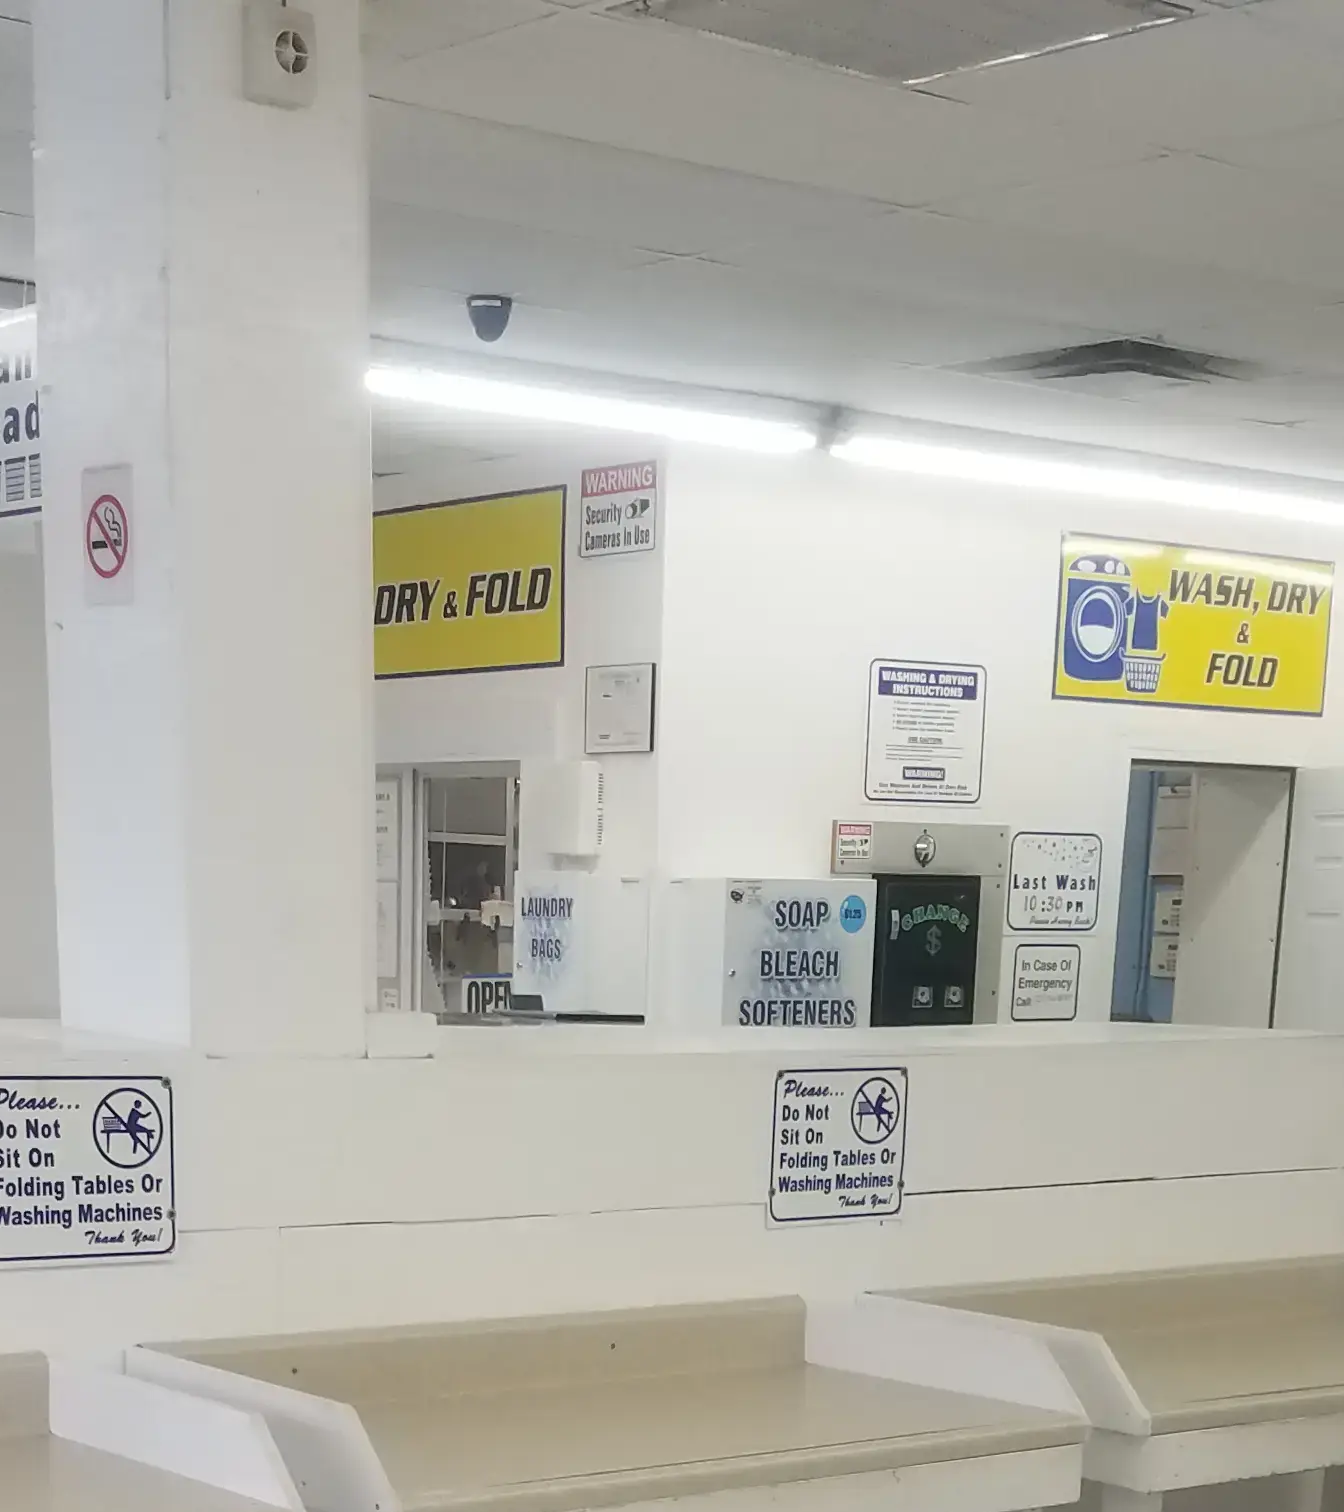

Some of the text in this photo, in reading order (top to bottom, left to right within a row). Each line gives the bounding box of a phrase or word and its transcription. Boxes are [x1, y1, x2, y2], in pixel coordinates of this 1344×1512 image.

[585, 465, 653, 494] WARNING
[585, 502, 622, 525] Security
[585, 525, 650, 551] Cameras In Use
[374, 567, 552, 625] DRY & FOLD
[1169, 569, 1326, 615] WASH, DRY
[1236, 623, 1250, 643] &
[881, 670, 926, 683] WASHING
[939, 675, 974, 686] DRYING
[1205, 653, 1278, 687] FOLD
[892, 684, 963, 697] INSTRUCTIONS
[1013, 874, 1095, 891] Last Wash
[521, 897, 574, 918] LAUNDRY
[774, 900, 830, 928] SOAP
[901, 904, 970, 932] CHANGE
[531, 938, 561, 959] BAGS
[760, 950, 839, 978] BLEACH
[1022, 959, 1031, 971] In
[1033, 959, 1058, 971] Case
[1018, 977, 1073, 991] Emergency
[739, 999, 856, 1027] SOFTENERS
[784, 1079, 844, 1098] Please...
[782, 1104, 829, 1121] Do Not
[26, 1118, 61, 1139] Not
[781, 1128, 823, 1145] Sit On
[29, 1148, 55, 1167] On
[780, 1148, 896, 1171] Folding Tables Or
[71, 1175, 134, 1195] Tables
[141, 1173, 163, 1194] Or
[778, 1172, 893, 1194] Washing Machines
[839, 1193, 893, 1209] Thank You!
[78, 1202, 163, 1224] Machines
[85, 1228, 163, 1247] Thank You!
